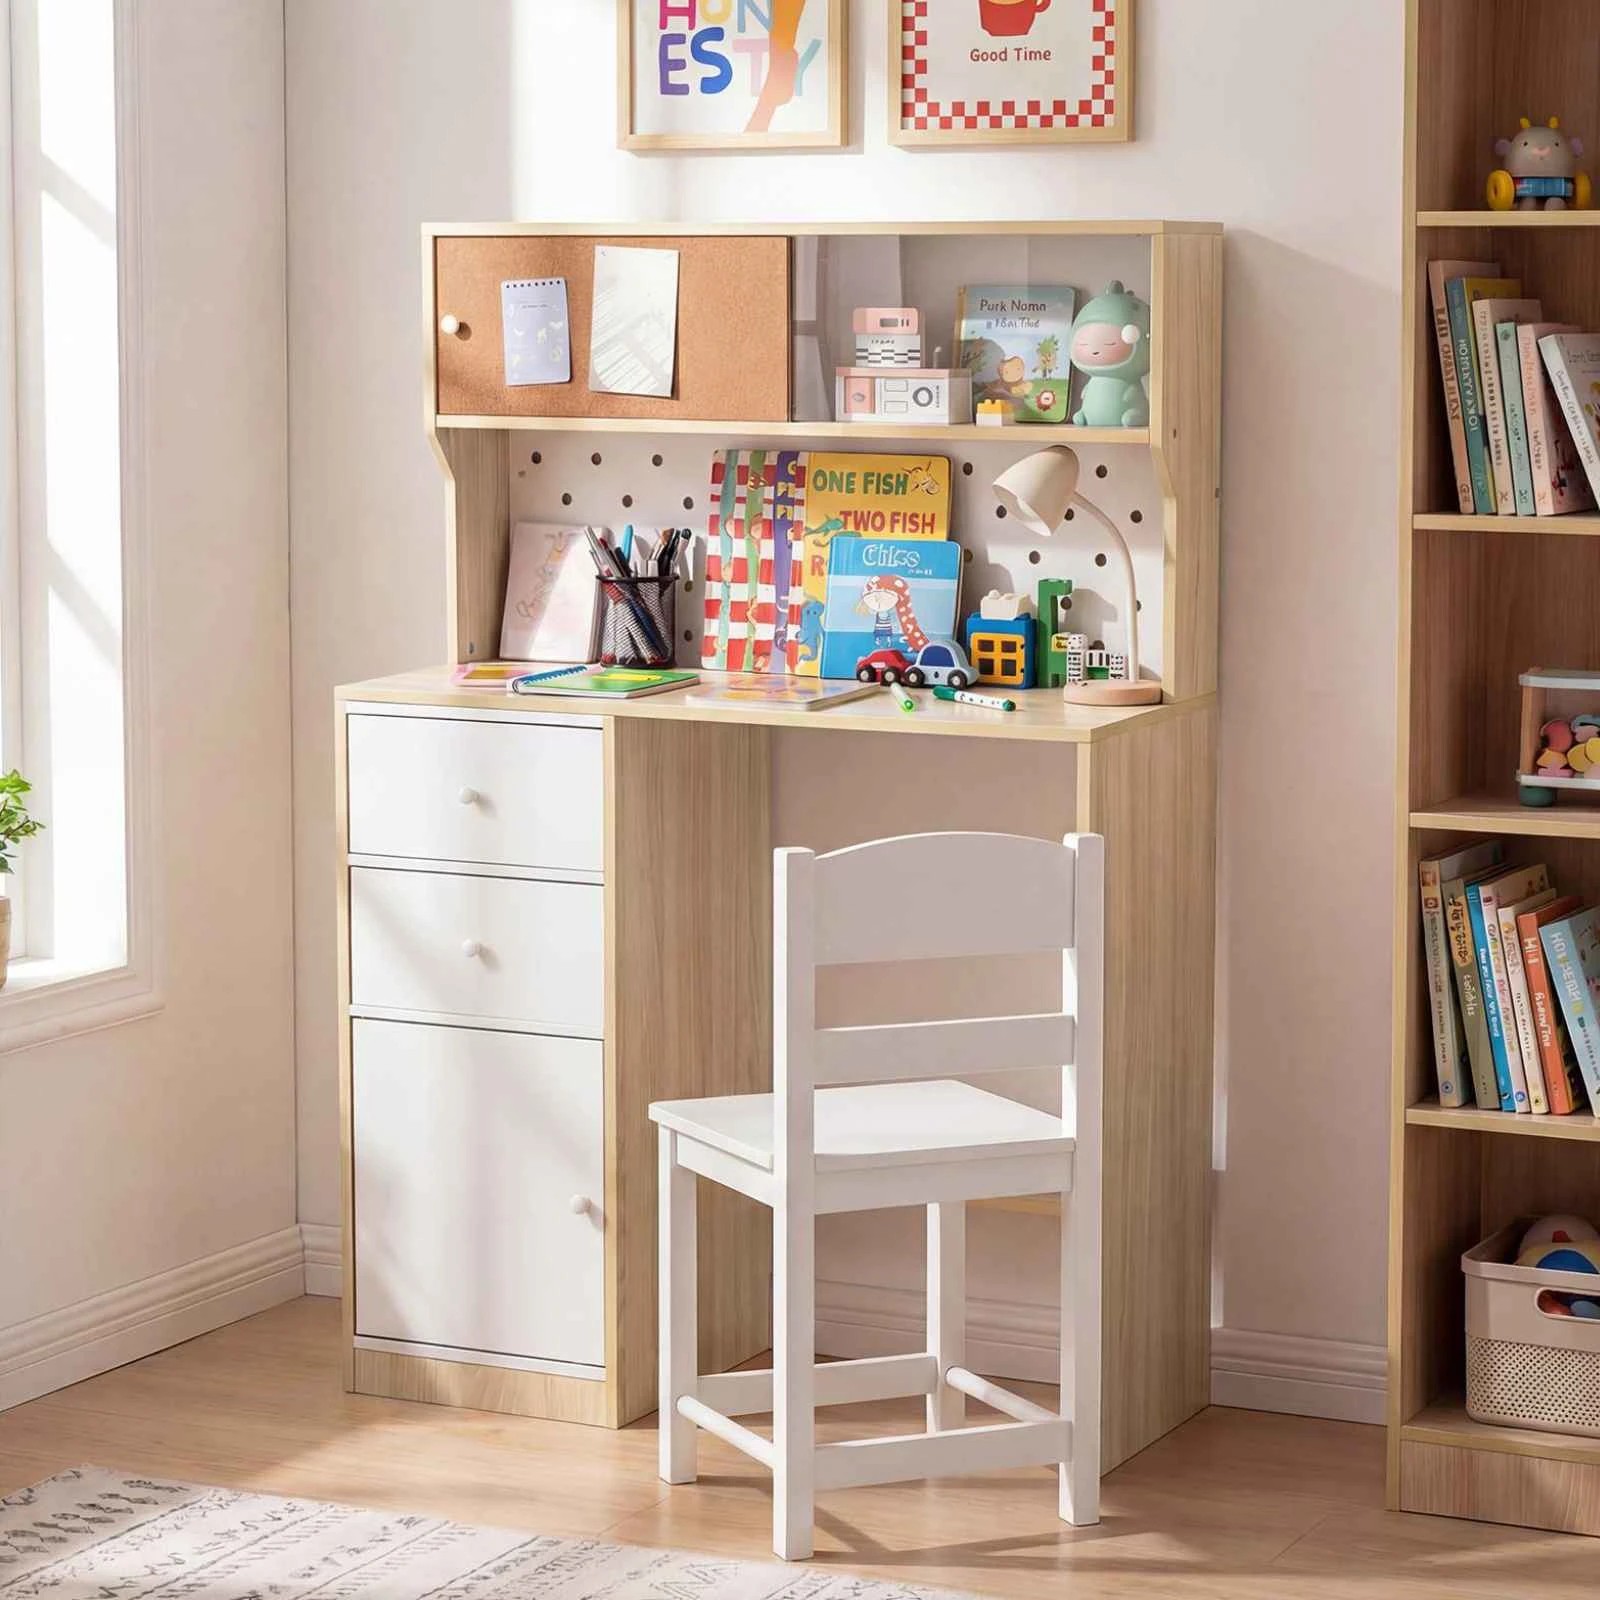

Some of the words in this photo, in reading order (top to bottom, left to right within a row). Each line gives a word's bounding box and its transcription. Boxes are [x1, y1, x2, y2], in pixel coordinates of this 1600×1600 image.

[970, 47, 1008, 62] Good
[1013, 46, 1051, 62] Time
[813, 469, 856, 494] ONE
[863, 472, 909, 495] FISH
[840, 510, 885, 532] TWO
[890, 512, 936, 534] FISH
